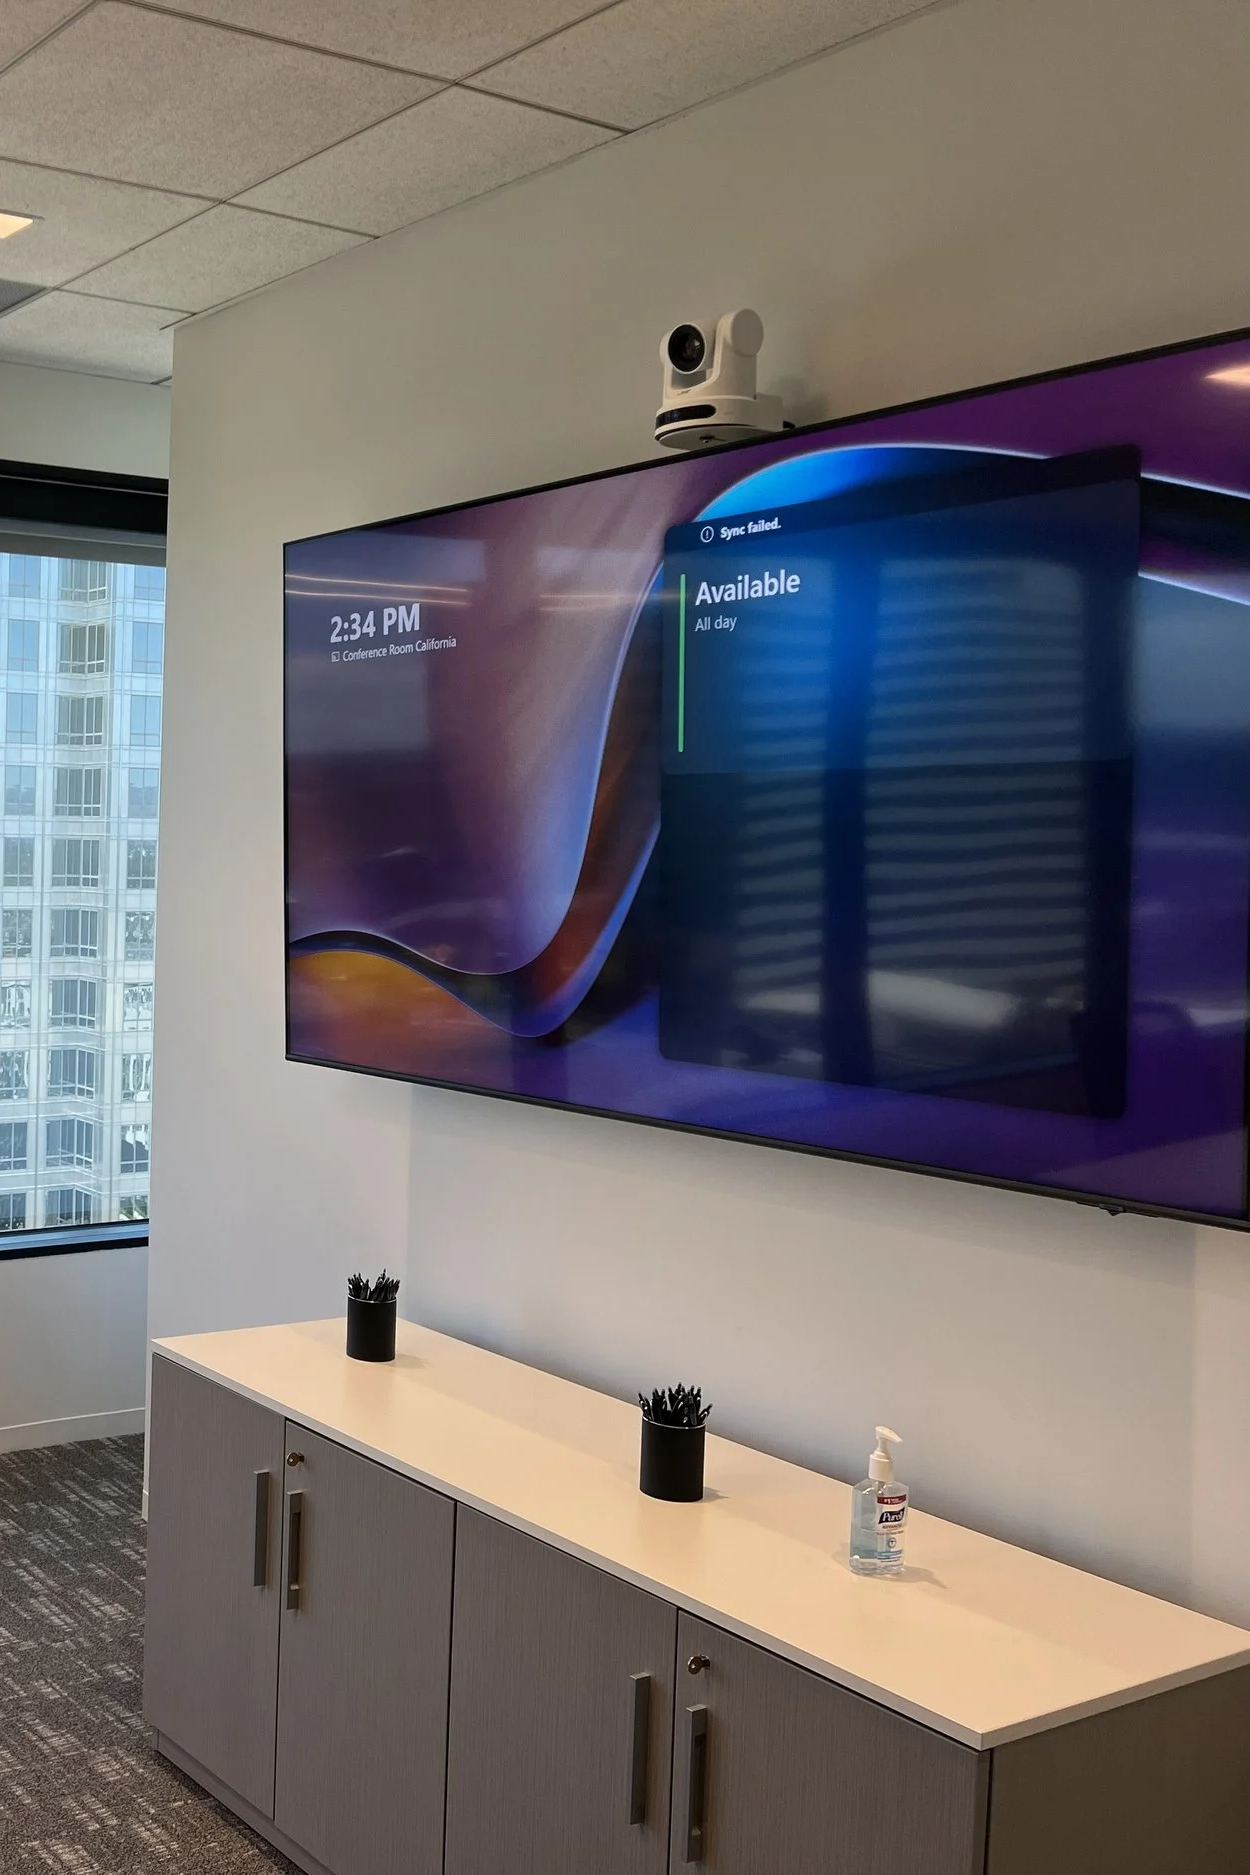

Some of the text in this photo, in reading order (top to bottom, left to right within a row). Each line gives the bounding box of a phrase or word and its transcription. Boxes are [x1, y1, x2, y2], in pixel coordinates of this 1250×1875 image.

[720, 517, 782, 541] Sync failed.
[695, 569, 800, 606] Available
[330, 603, 420, 643] 2:34 PM
[695, 614, 738, 632] All day
[342, 636, 457, 662] Conference Room California
